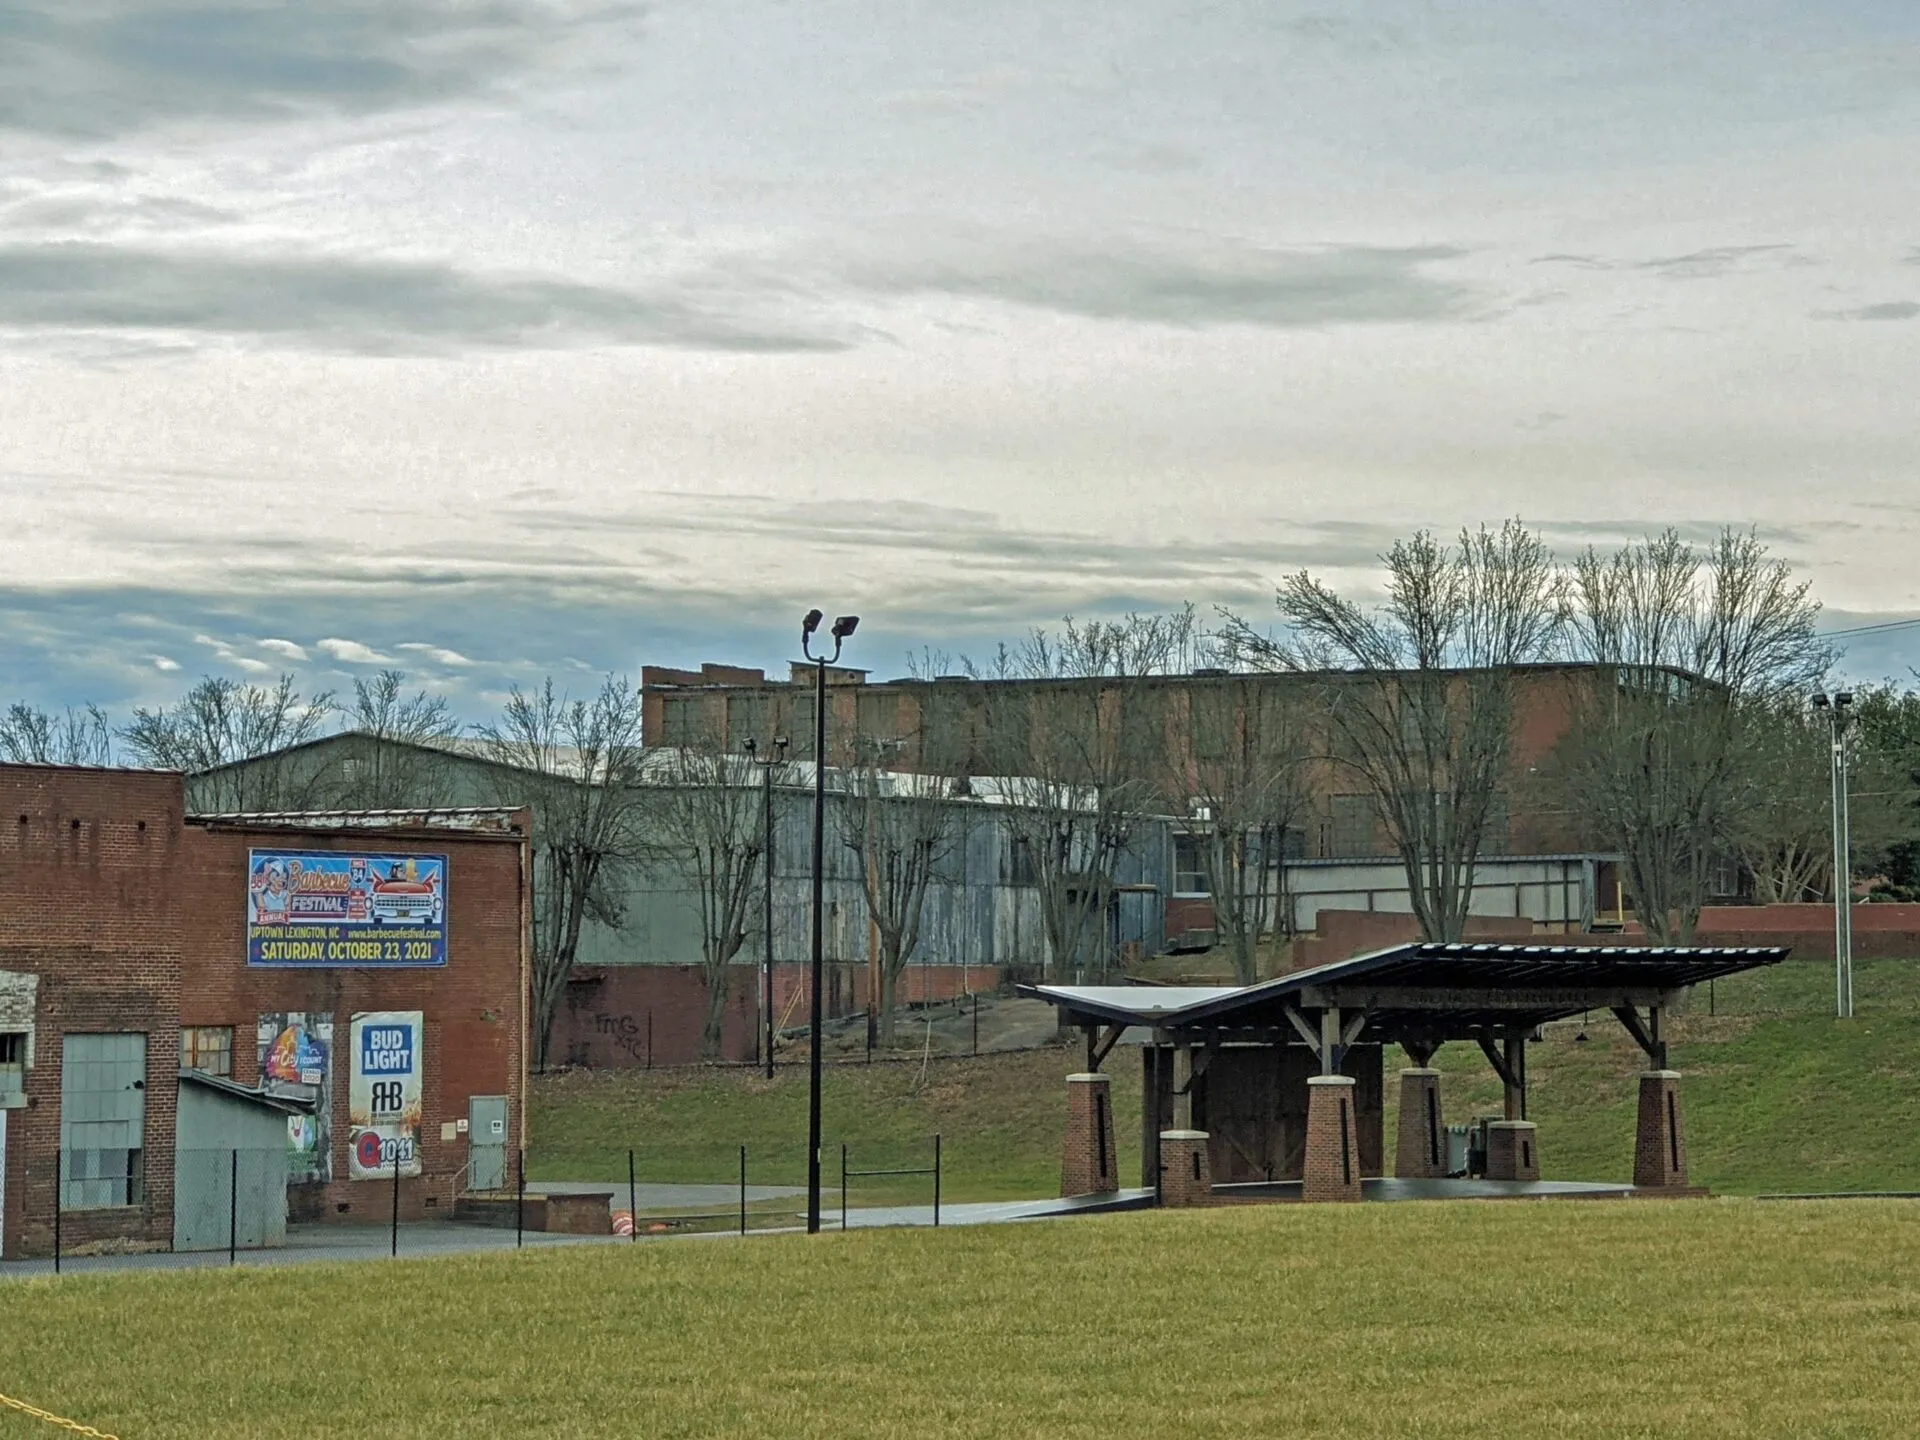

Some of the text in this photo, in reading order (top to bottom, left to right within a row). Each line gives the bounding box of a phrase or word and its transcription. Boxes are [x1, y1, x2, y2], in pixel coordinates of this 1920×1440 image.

[287, 860, 350, 894] Barbecue
[291, 896, 344, 912] FESTIVAL
[259, 911, 286, 922] ANNUAL
[250, 926, 442, 939] UPTOWN LEXINGTON, NC www.barbecuefestival.com
[261, 942, 432, 961] SATURDAY, OCTOBER 23, 2021
[370, 1030, 403, 1050] BUD
[270, 1055, 281, 1063] MY
[280, 1050, 299, 1067] City
[303, 1056, 322, 1064] COUNT
[364, 1051, 410, 1070] LIGHT
